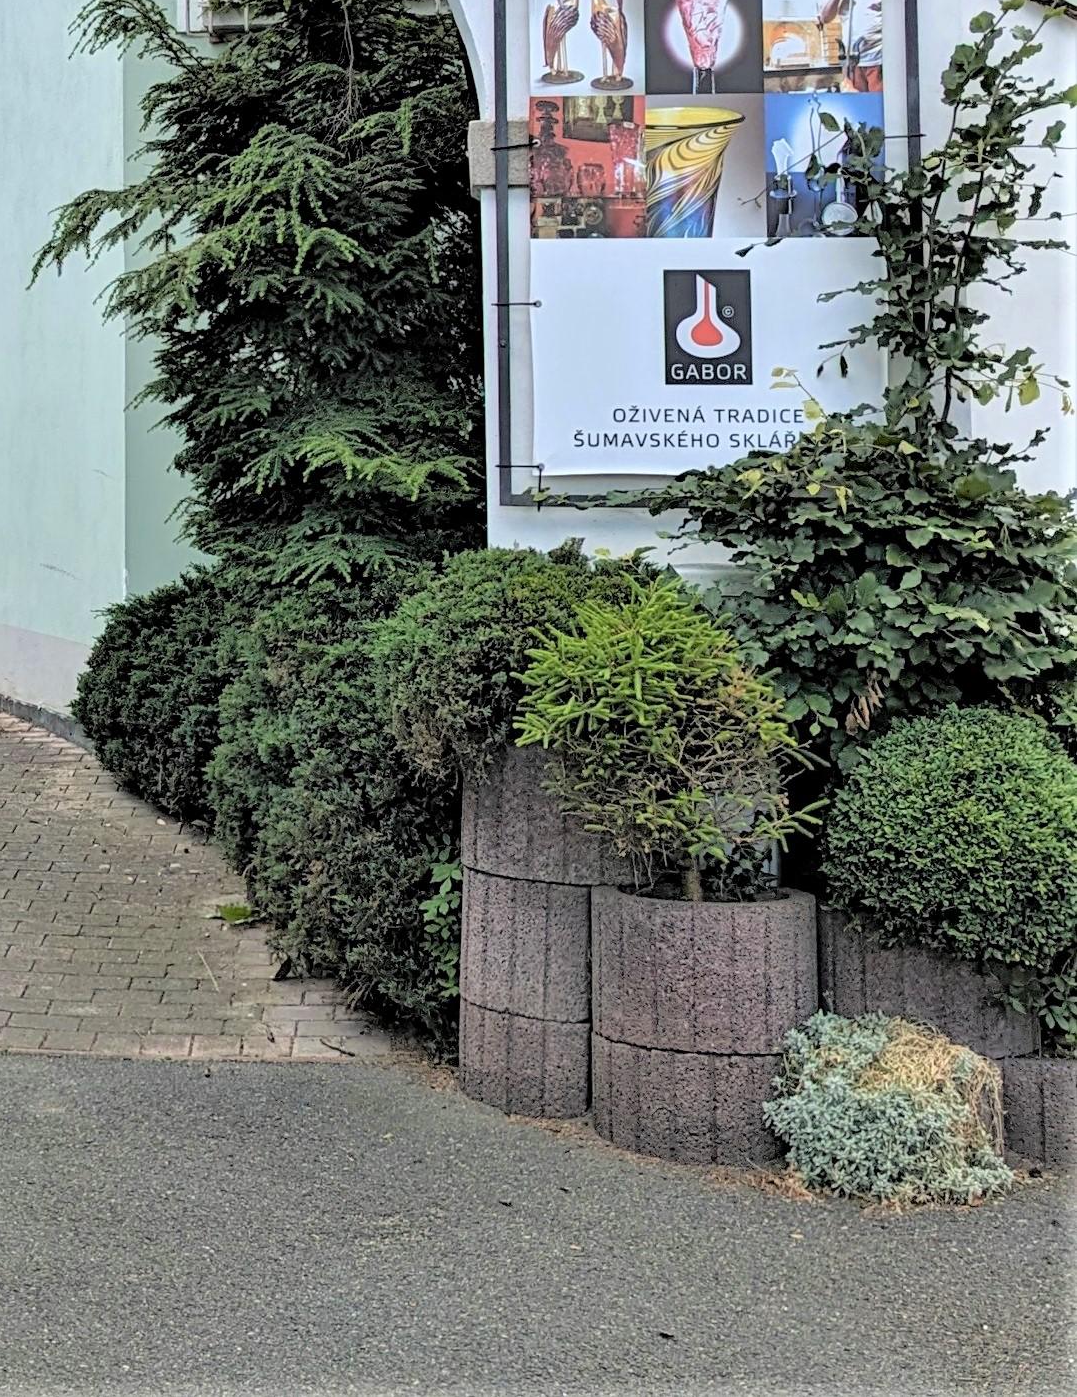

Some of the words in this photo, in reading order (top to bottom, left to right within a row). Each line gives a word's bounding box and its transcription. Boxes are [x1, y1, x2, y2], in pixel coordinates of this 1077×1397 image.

[671, 364, 747, 380] GABOR
[613, 405, 705, 423] OŽIVENÁ
[714, 408, 804, 423] TRADICE
[574, 429, 720, 448] ŠUMAVSKÉHO
[730, 429, 796, 448] SKLÁŘ
